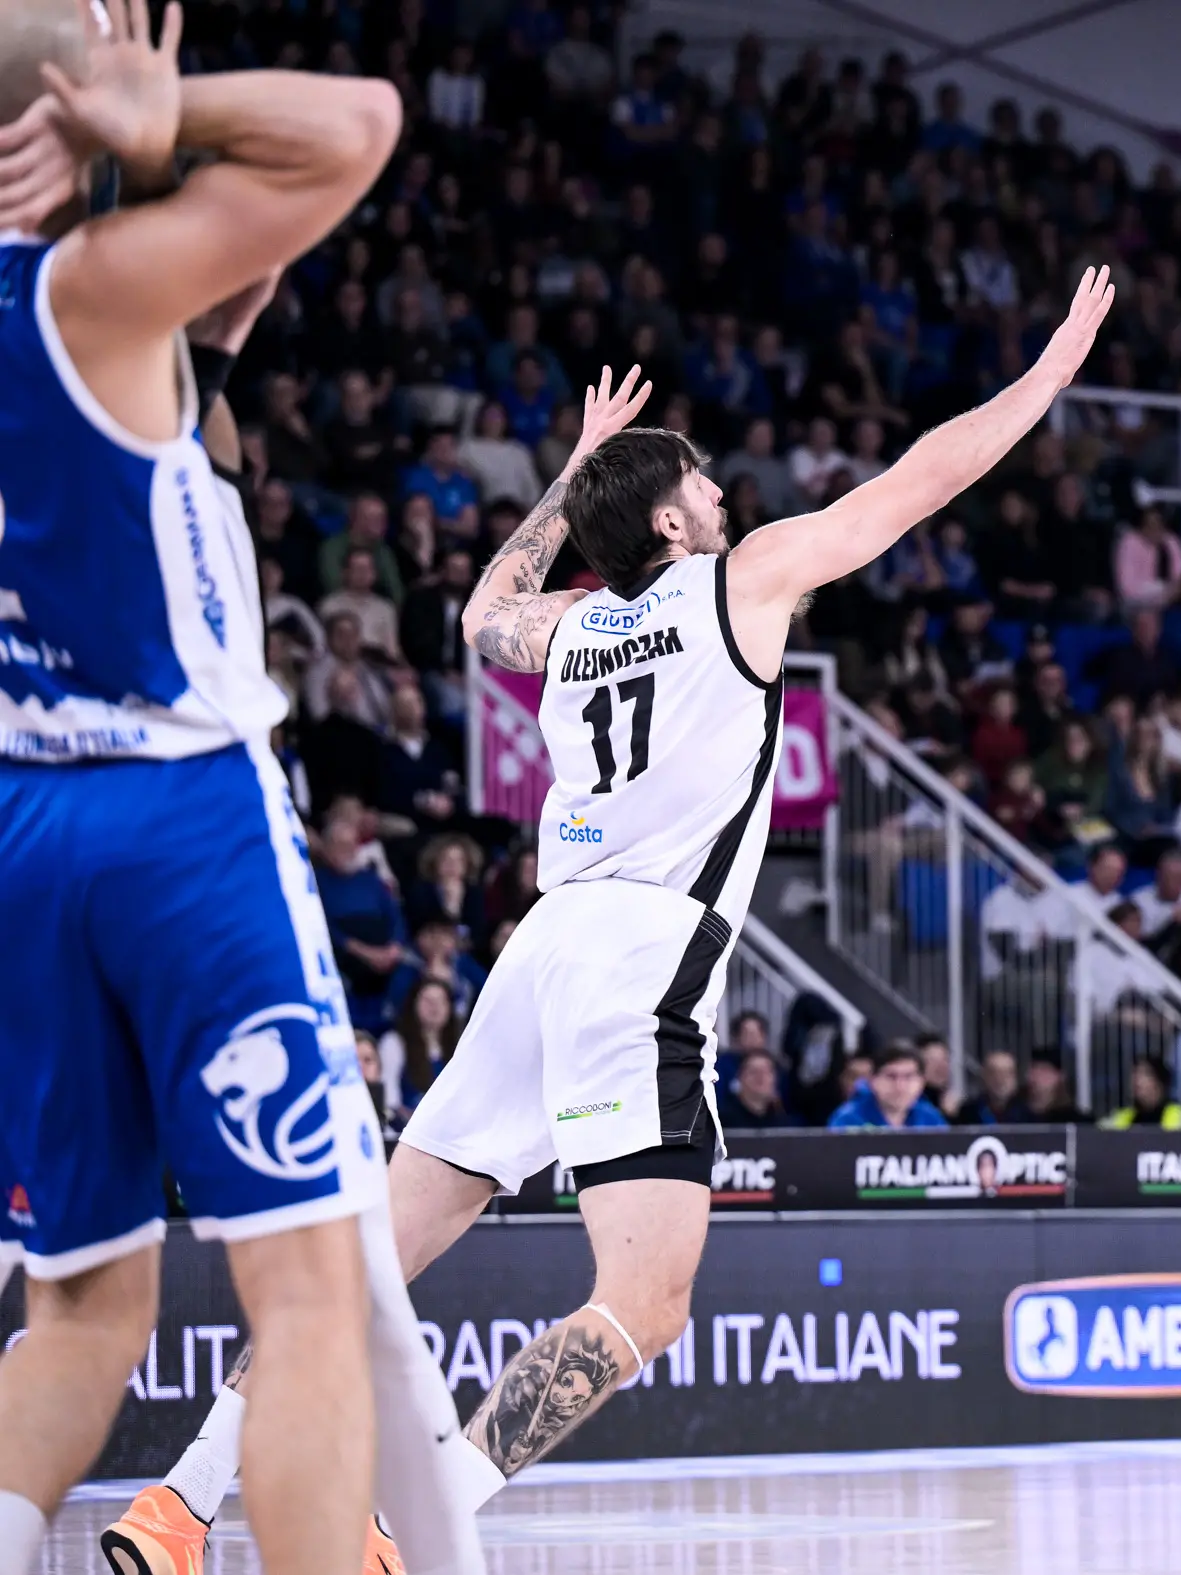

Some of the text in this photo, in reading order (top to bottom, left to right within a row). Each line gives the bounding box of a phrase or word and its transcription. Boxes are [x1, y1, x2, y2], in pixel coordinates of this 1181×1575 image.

[561, 626, 684, 683] OLEJNICZAK
[582, 673, 655, 794] 17
[559, 823, 603, 843] Costa
[713, 1308, 962, 1385] ITALIANE
